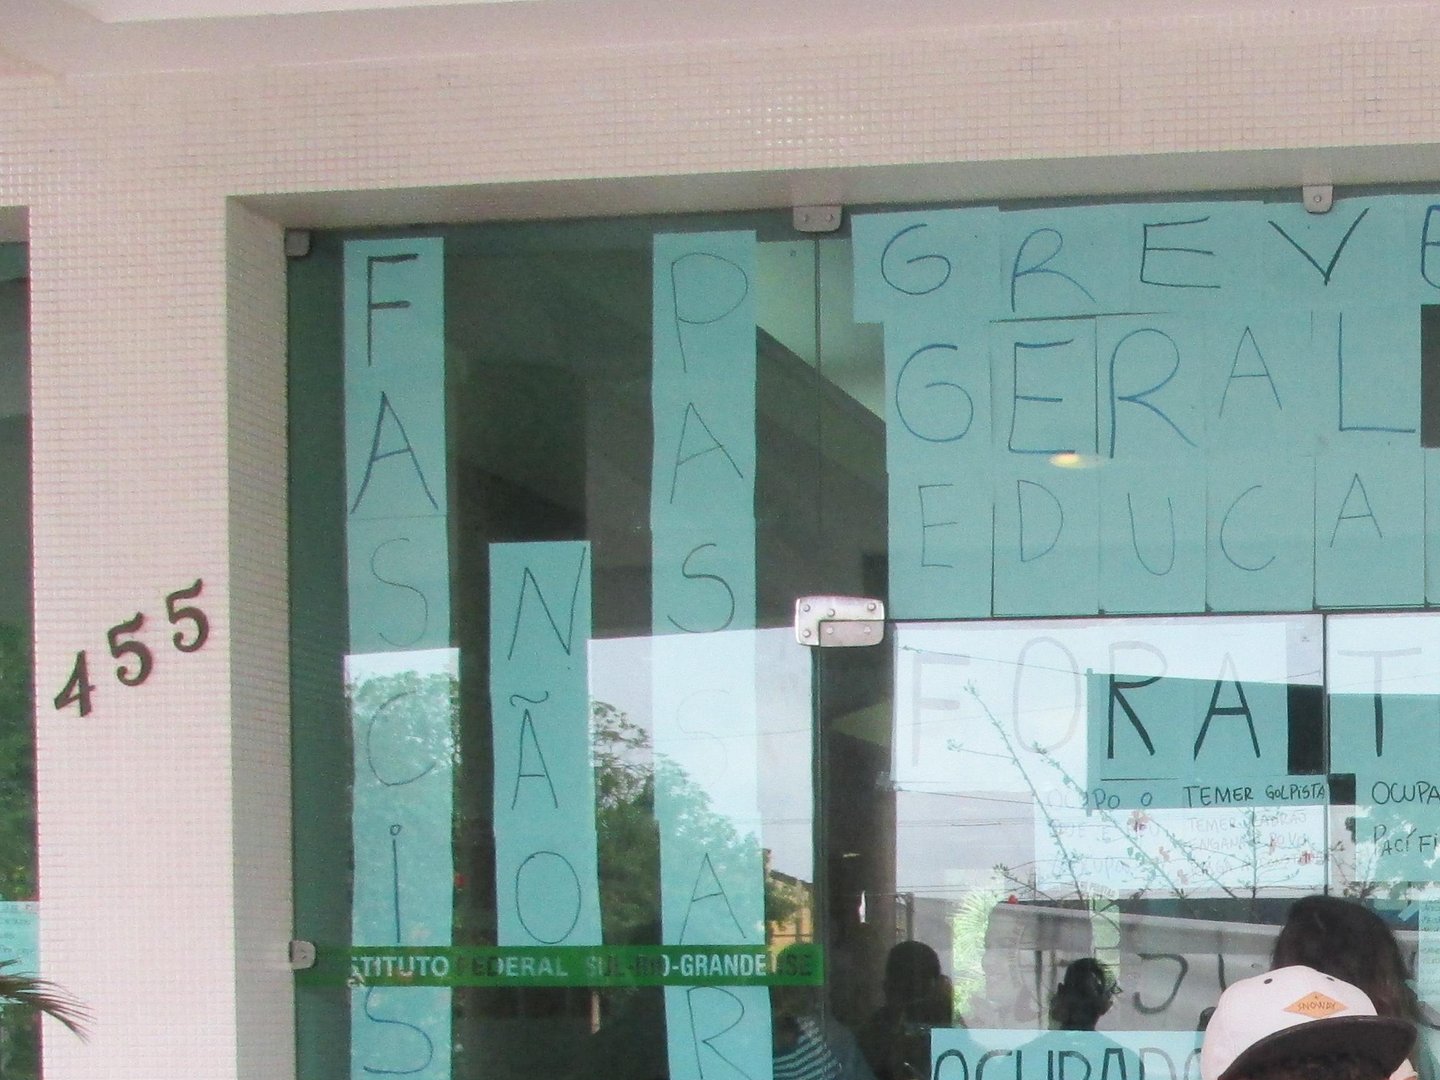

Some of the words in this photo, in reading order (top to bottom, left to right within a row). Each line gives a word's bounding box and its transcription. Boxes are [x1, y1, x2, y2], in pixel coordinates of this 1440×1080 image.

[895, 312, 1417, 458] GERAL
[53, 577, 210, 718] 455
[910, 636, 1261, 768] FORA
[1183, 784, 1254, 808] TEMER
